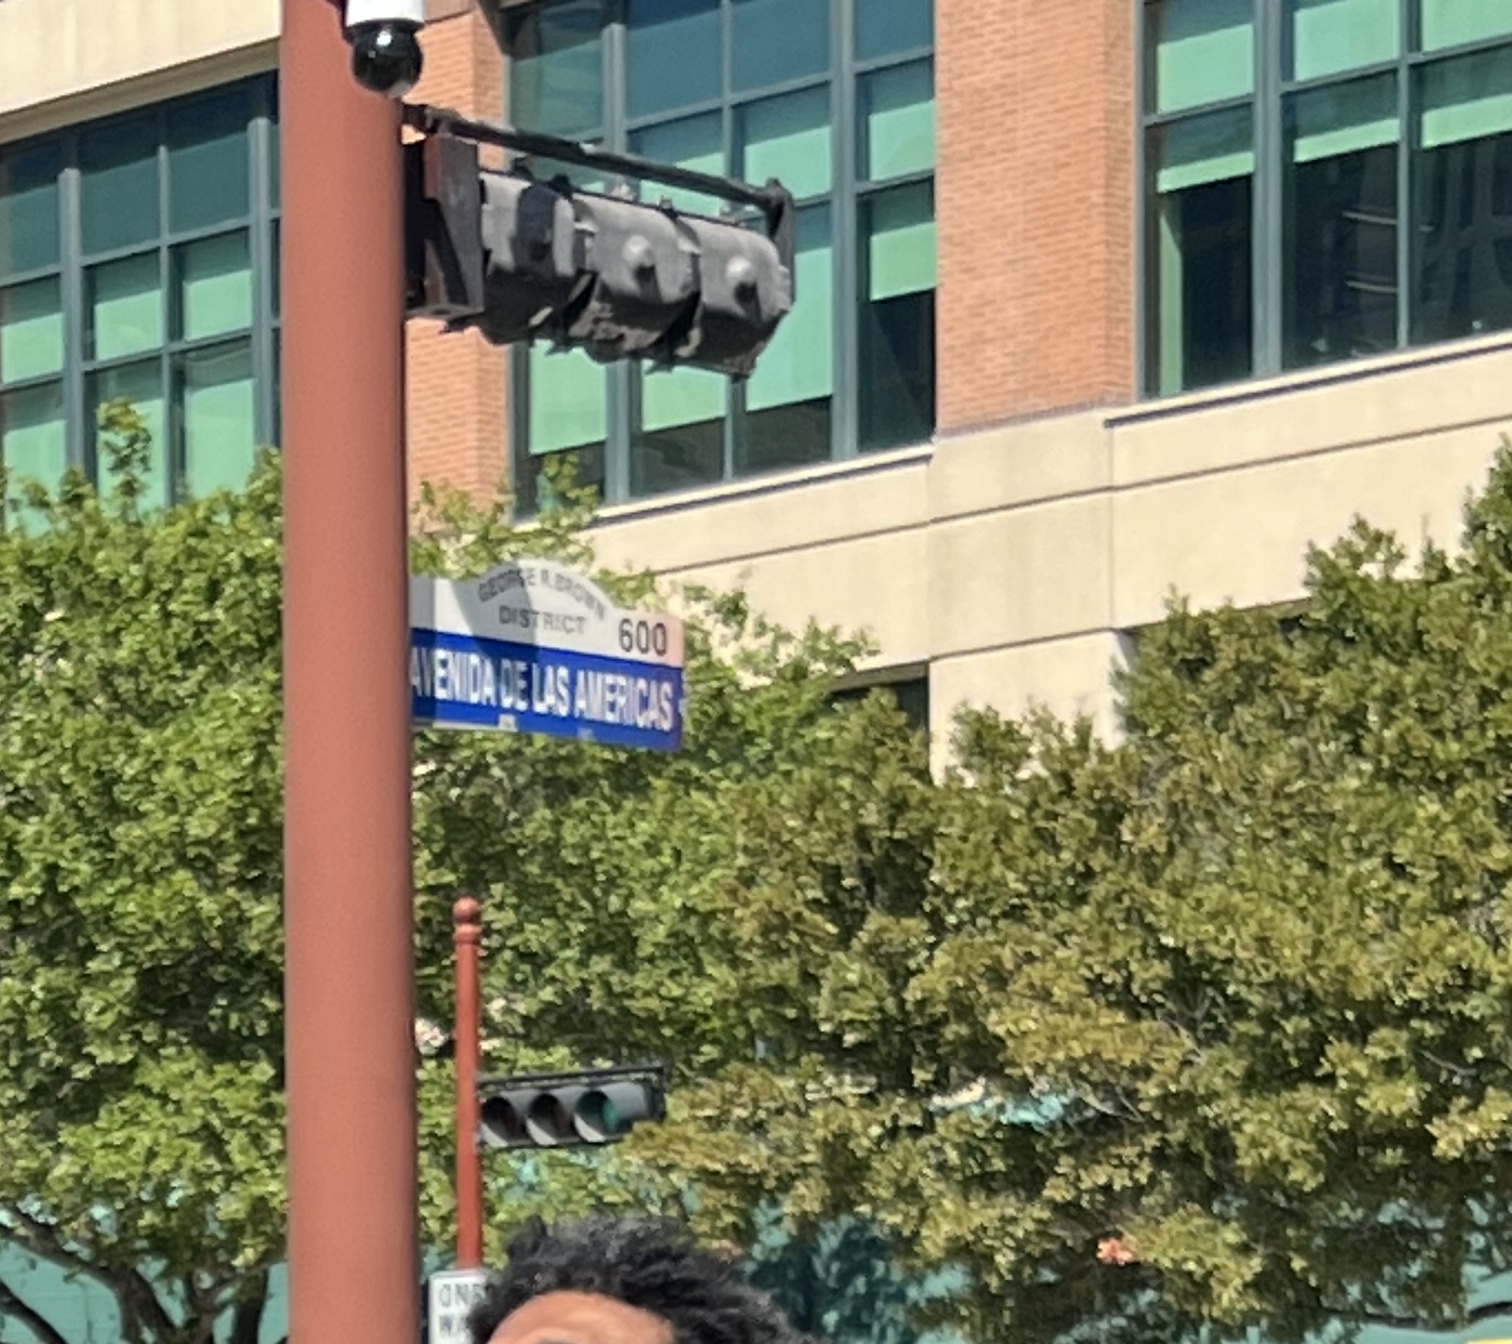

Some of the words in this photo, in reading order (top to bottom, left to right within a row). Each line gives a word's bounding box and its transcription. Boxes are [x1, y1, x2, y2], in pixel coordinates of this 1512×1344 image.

[499, 605, 585, 634] DISTRICT
[619, 617, 668, 657] 600
[500, 658, 529, 712] DE
[532, 662, 570, 717] LAS
[575, 669, 674, 732] AMERICAS
